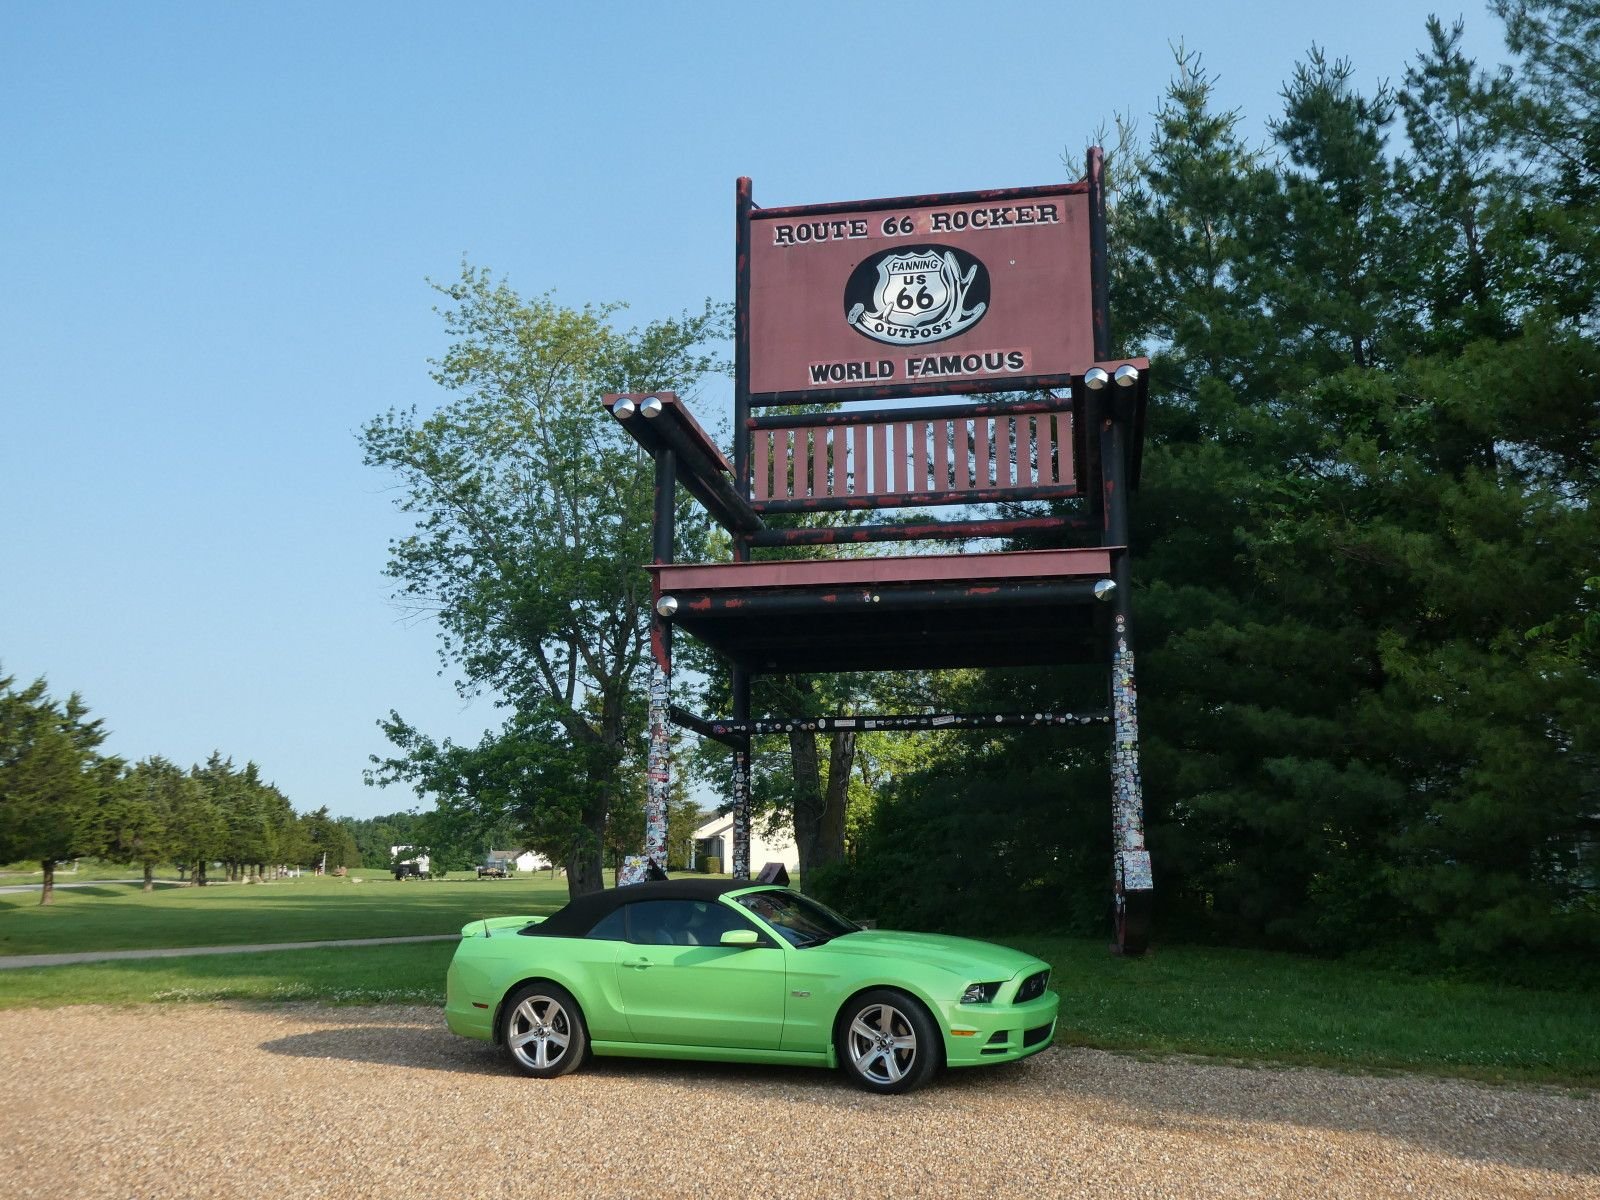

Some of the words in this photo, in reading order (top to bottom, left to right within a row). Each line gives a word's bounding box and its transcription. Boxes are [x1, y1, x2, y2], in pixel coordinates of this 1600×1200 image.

[774, 219, 868, 246] ROUTE
[881, 215, 915, 237] 66
[930, 204, 1060, 233] ROCKER
[891, 259, 939, 272] FANNING
[903, 274, 927, 286] US
[896, 285, 935, 310] 66
[874, 320, 952, 339] OUTPOST
[809, 360, 895, 385] WORLD
[905, 351, 1025, 379] FAMOUS
